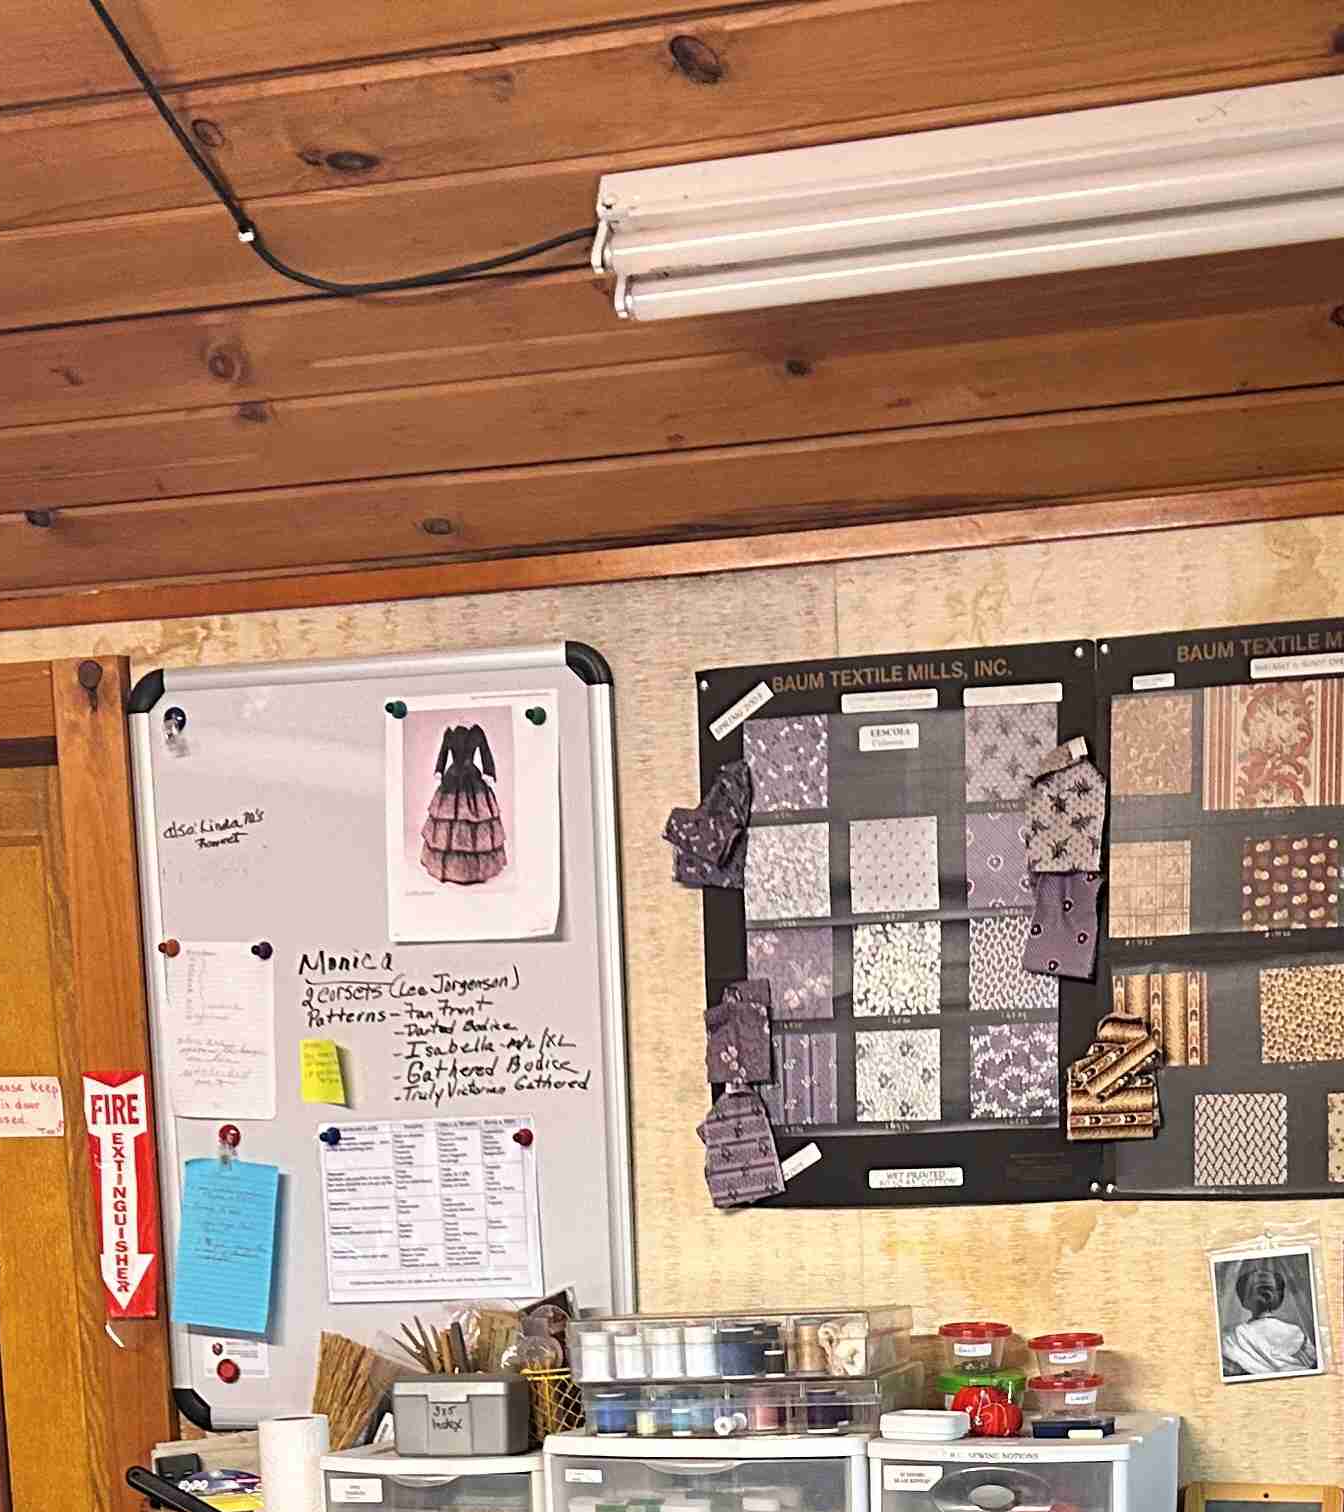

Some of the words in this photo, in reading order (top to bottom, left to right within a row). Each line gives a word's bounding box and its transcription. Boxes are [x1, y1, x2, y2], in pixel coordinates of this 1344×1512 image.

[1177, 641, 1234, 664] BAUM
[1240, 632, 1321, 659] TEXTILE
[772, 670, 824, 693] BAUM
[830, 664, 903, 688] TEXTILE
[907, 661, 968, 683] MILLS,
[974, 658, 1013, 678] INC.
[299, 951, 394, 976] Monica
[308, 1007, 386, 1028] Patterns
[91, 1094, 140, 1125] FIRE
[112, 1132, 130, 1293] EXTINGUISHER
